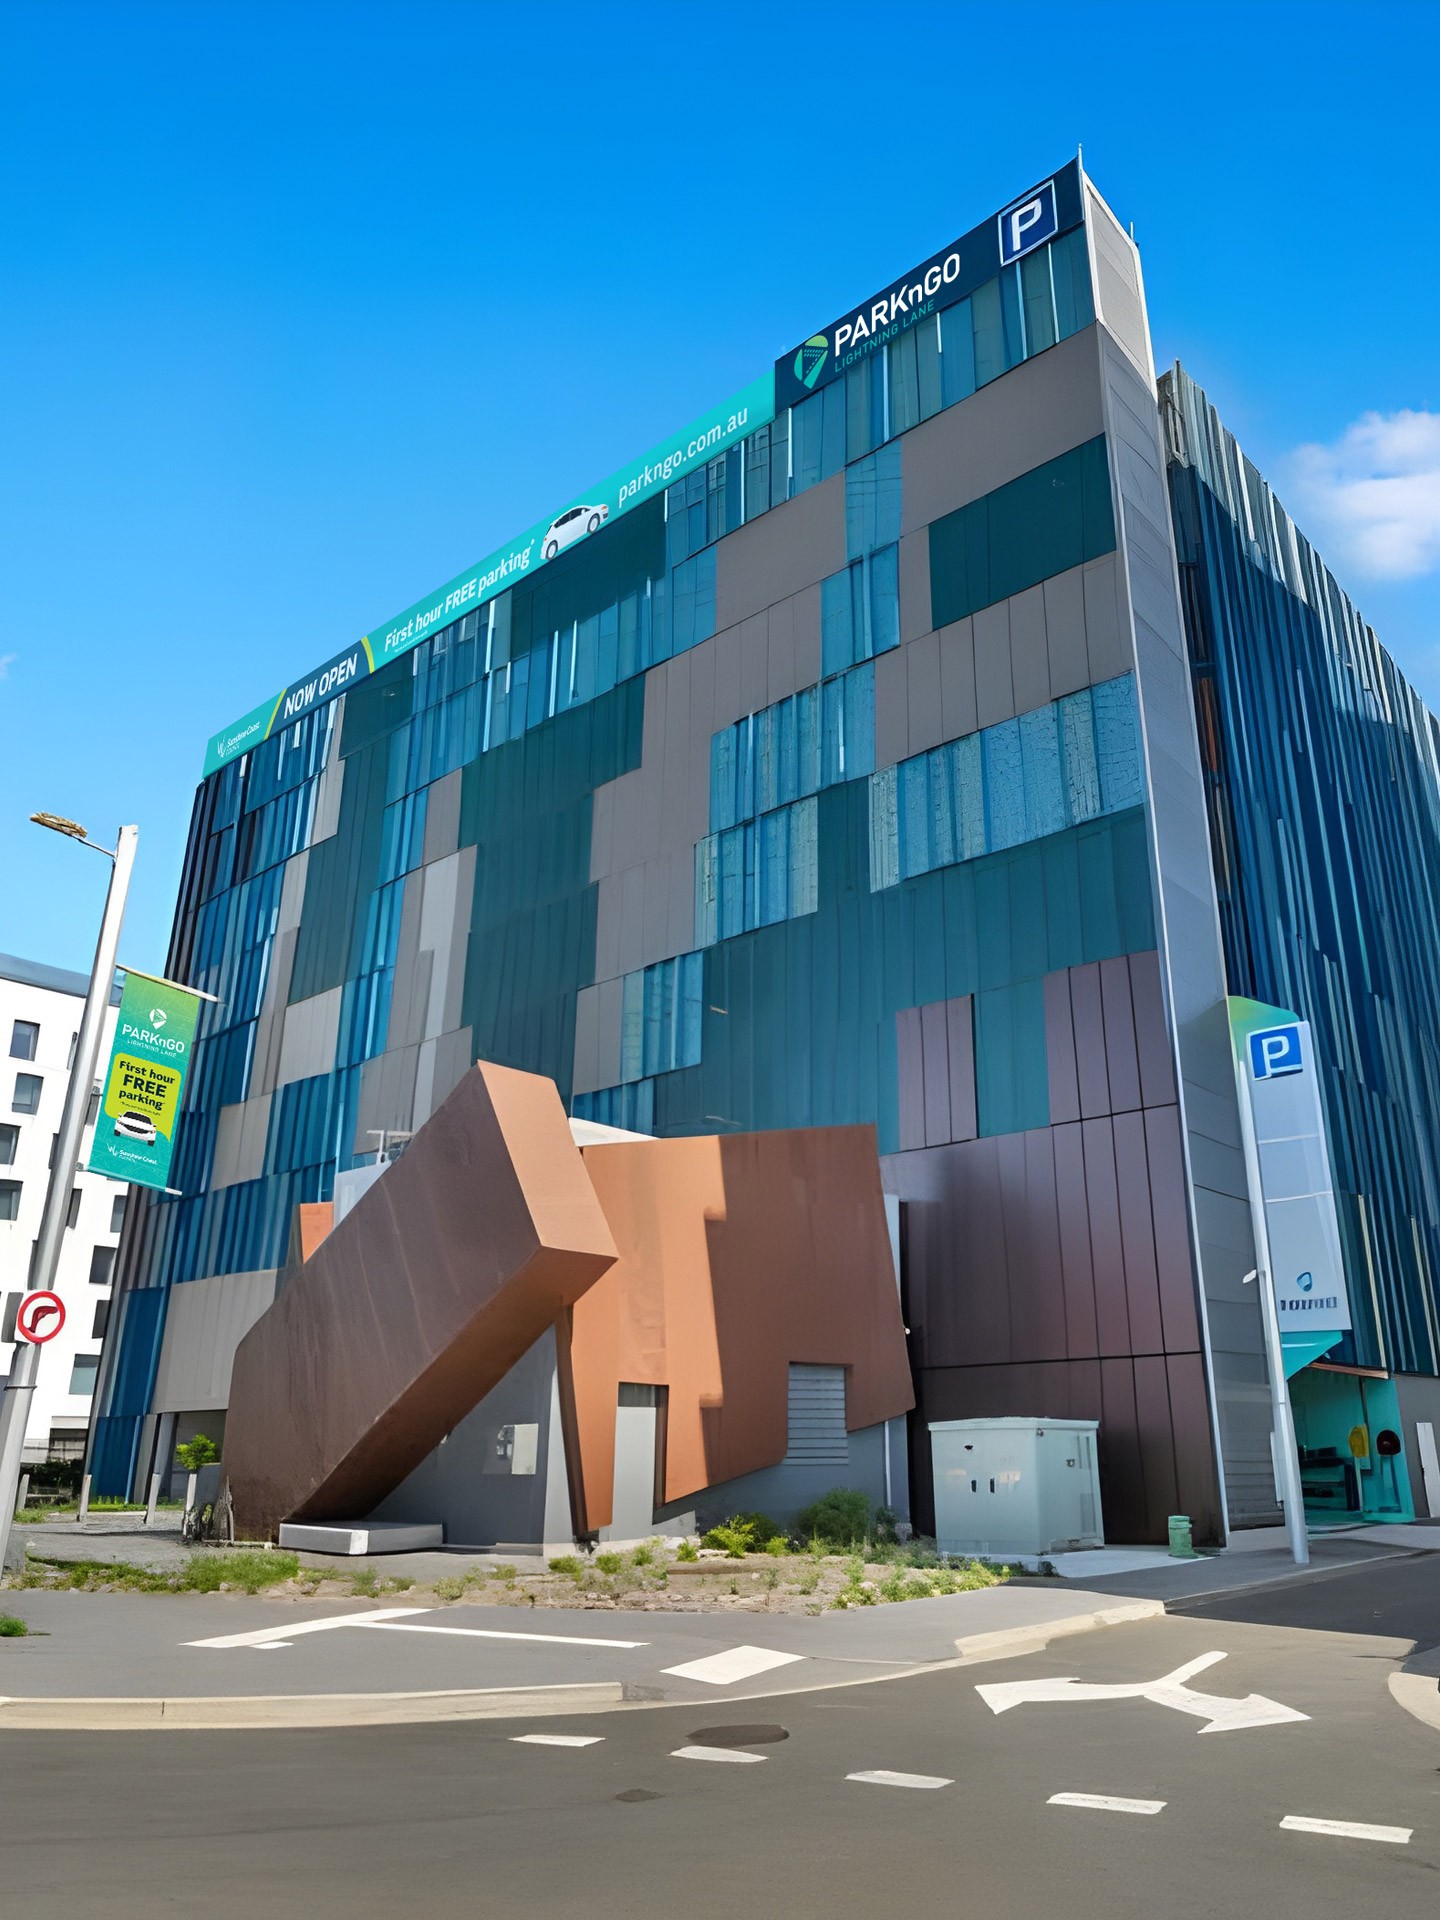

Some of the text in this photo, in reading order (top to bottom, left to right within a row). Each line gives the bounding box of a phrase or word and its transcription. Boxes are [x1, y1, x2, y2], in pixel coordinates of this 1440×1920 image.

[1011, 198, 1042, 252] P
[835, 253, 960, 357] PARKnGO
[835, 299, 935, 372] LIGHTNING LANE
[618, 407, 748, 508] parkngo.com.au
[384, 619, 414, 652] First
[414, 613, 443, 633] hour
[445, 578, 478, 614] FREE
[283, 652, 358, 719] NOW OPEN
[122, 1023, 185, 1053] PARKnGO
[1262, 1035, 1290, 1078] P
[119, 1060, 175, 1084] First hour
[123, 1073, 167, 1098] FREE
